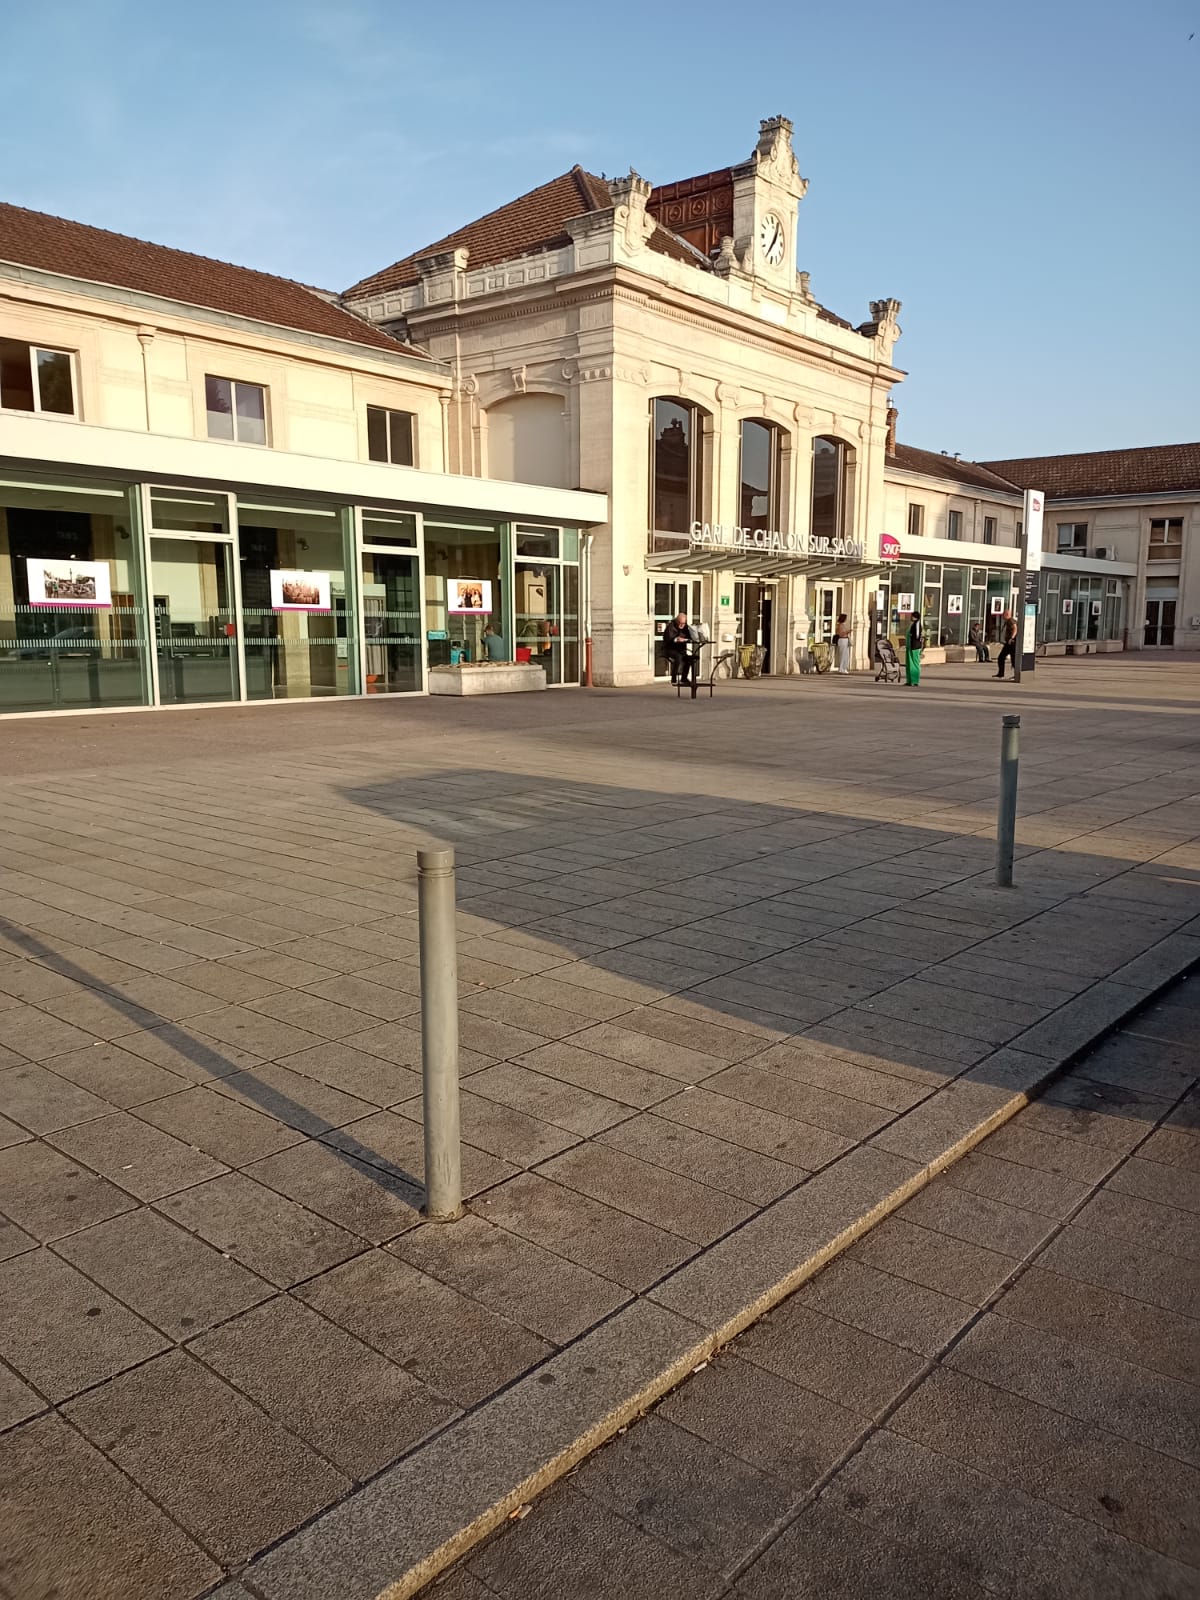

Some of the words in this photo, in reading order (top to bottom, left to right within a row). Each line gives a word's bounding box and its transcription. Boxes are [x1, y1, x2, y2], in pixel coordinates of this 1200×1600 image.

[733, 526, 752, 546] DE
[753, 528, 805, 552] CHALON
[808, 534, 830, 553] SUR
[831, 535, 869, 557] SAÔNE
[882, 543, 902, 556] SNCF
